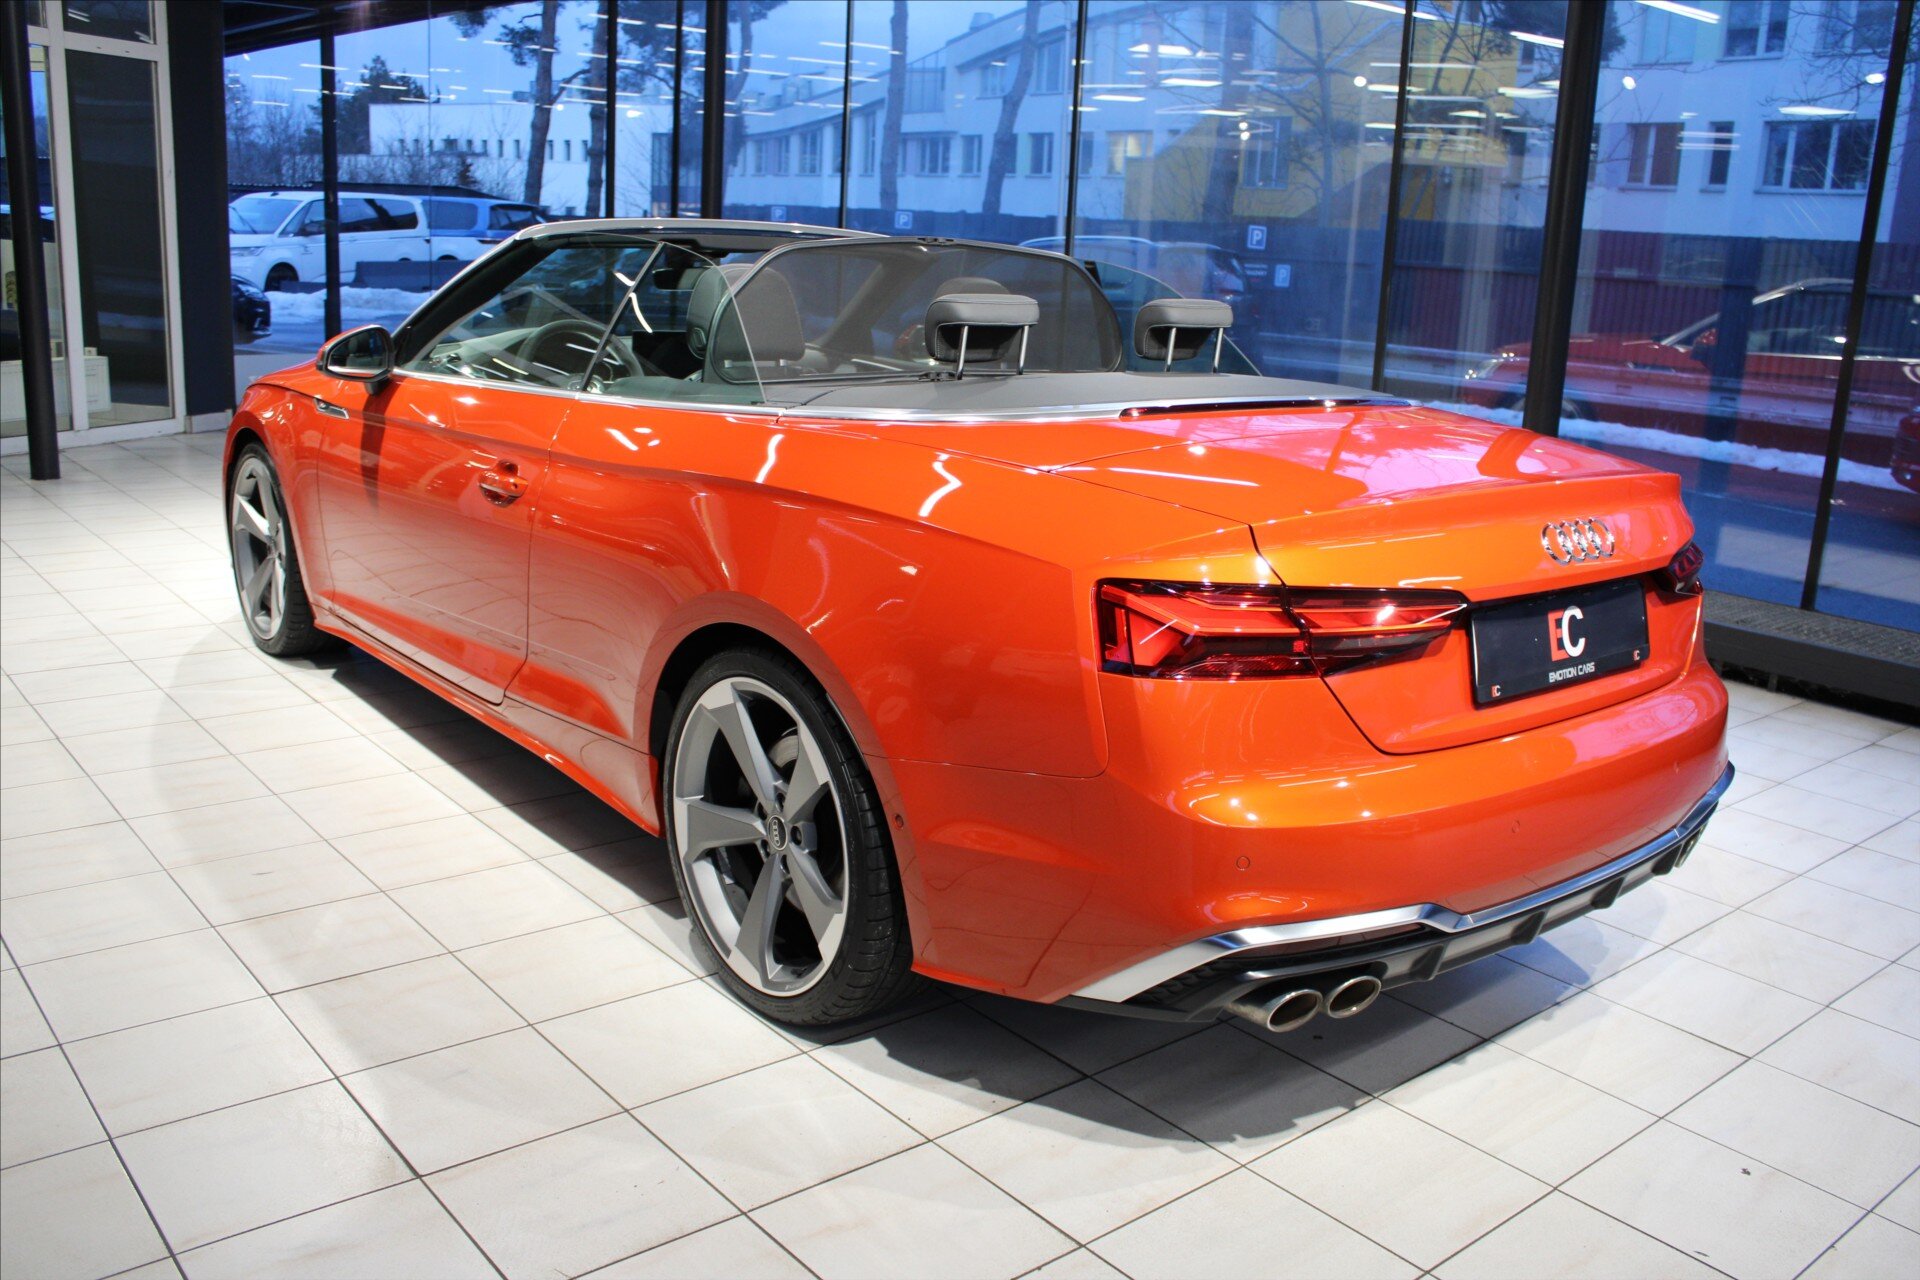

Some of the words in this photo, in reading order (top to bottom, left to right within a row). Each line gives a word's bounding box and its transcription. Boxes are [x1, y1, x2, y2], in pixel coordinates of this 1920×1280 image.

[900, 214, 908, 225] P
[1252, 230, 1262, 245] P
[1279, 268, 1287, 282] P
[1548, 605, 1586, 662] EC
[1549, 667, 1577, 683] EMOTION
[1578, 662, 1595, 675] CARS
